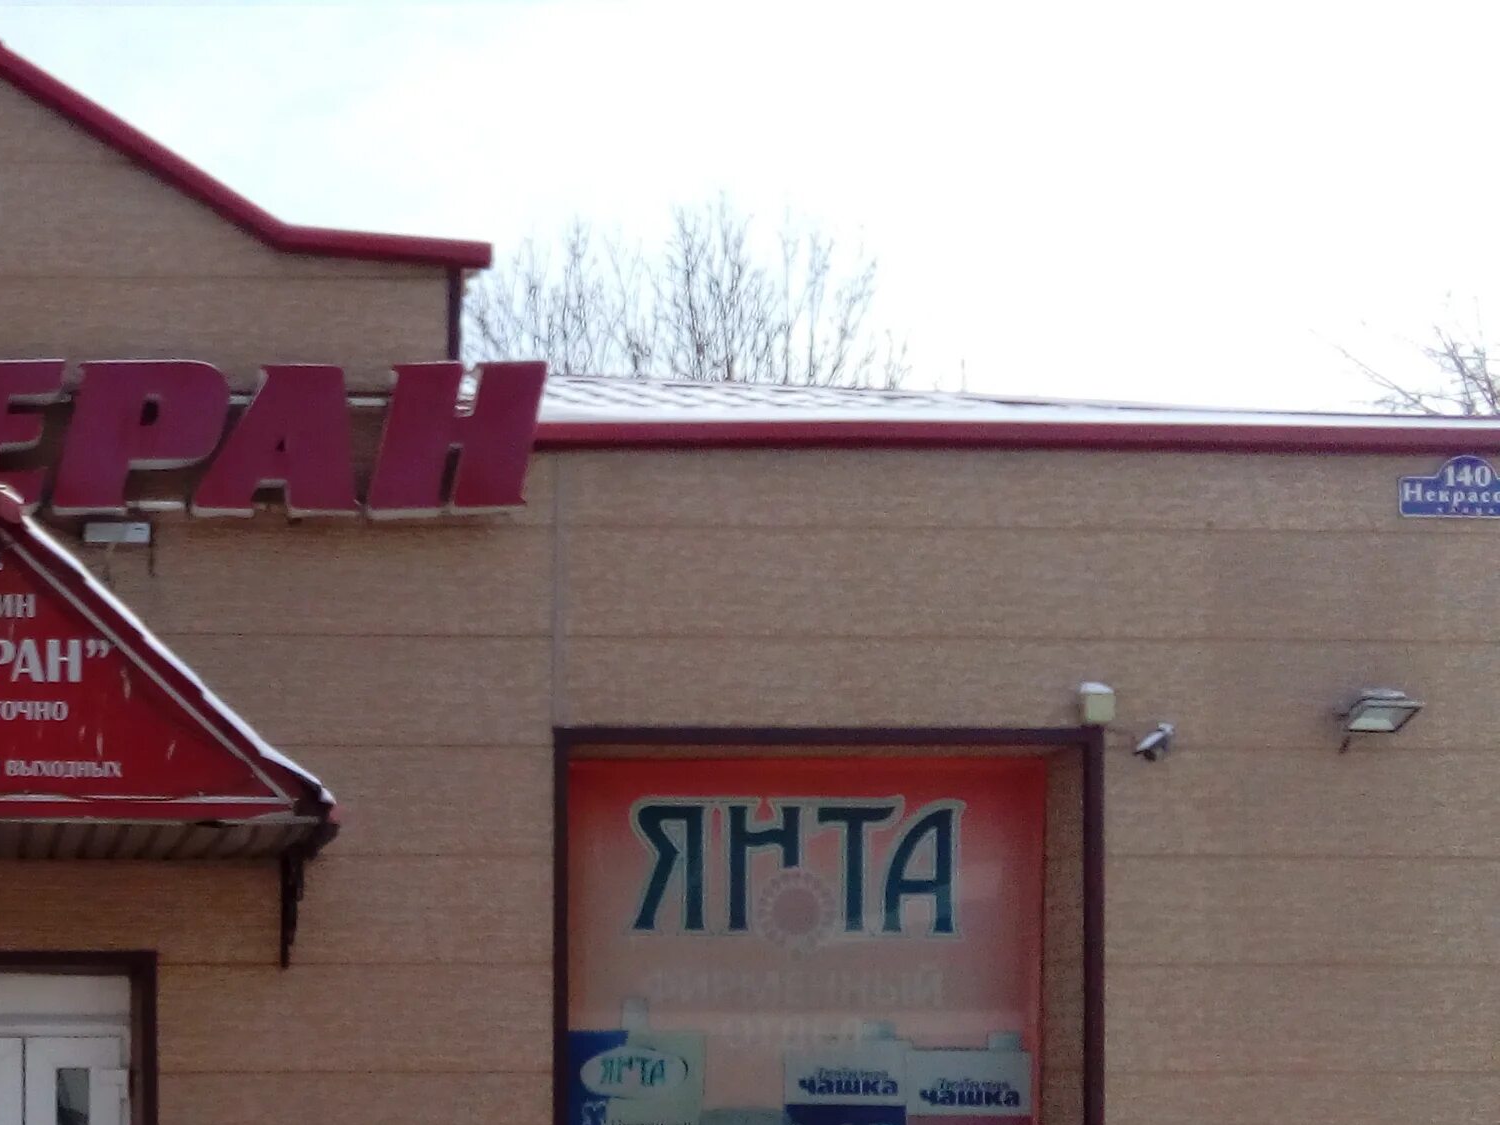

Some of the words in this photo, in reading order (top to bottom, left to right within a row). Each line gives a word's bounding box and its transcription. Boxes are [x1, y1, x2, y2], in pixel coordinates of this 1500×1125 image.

[1445, 465, 1492, 487] 140
[5, 760, 124, 779] ВЫХОДНЫХ
[627, 797, 964, 936] ЯНТА
